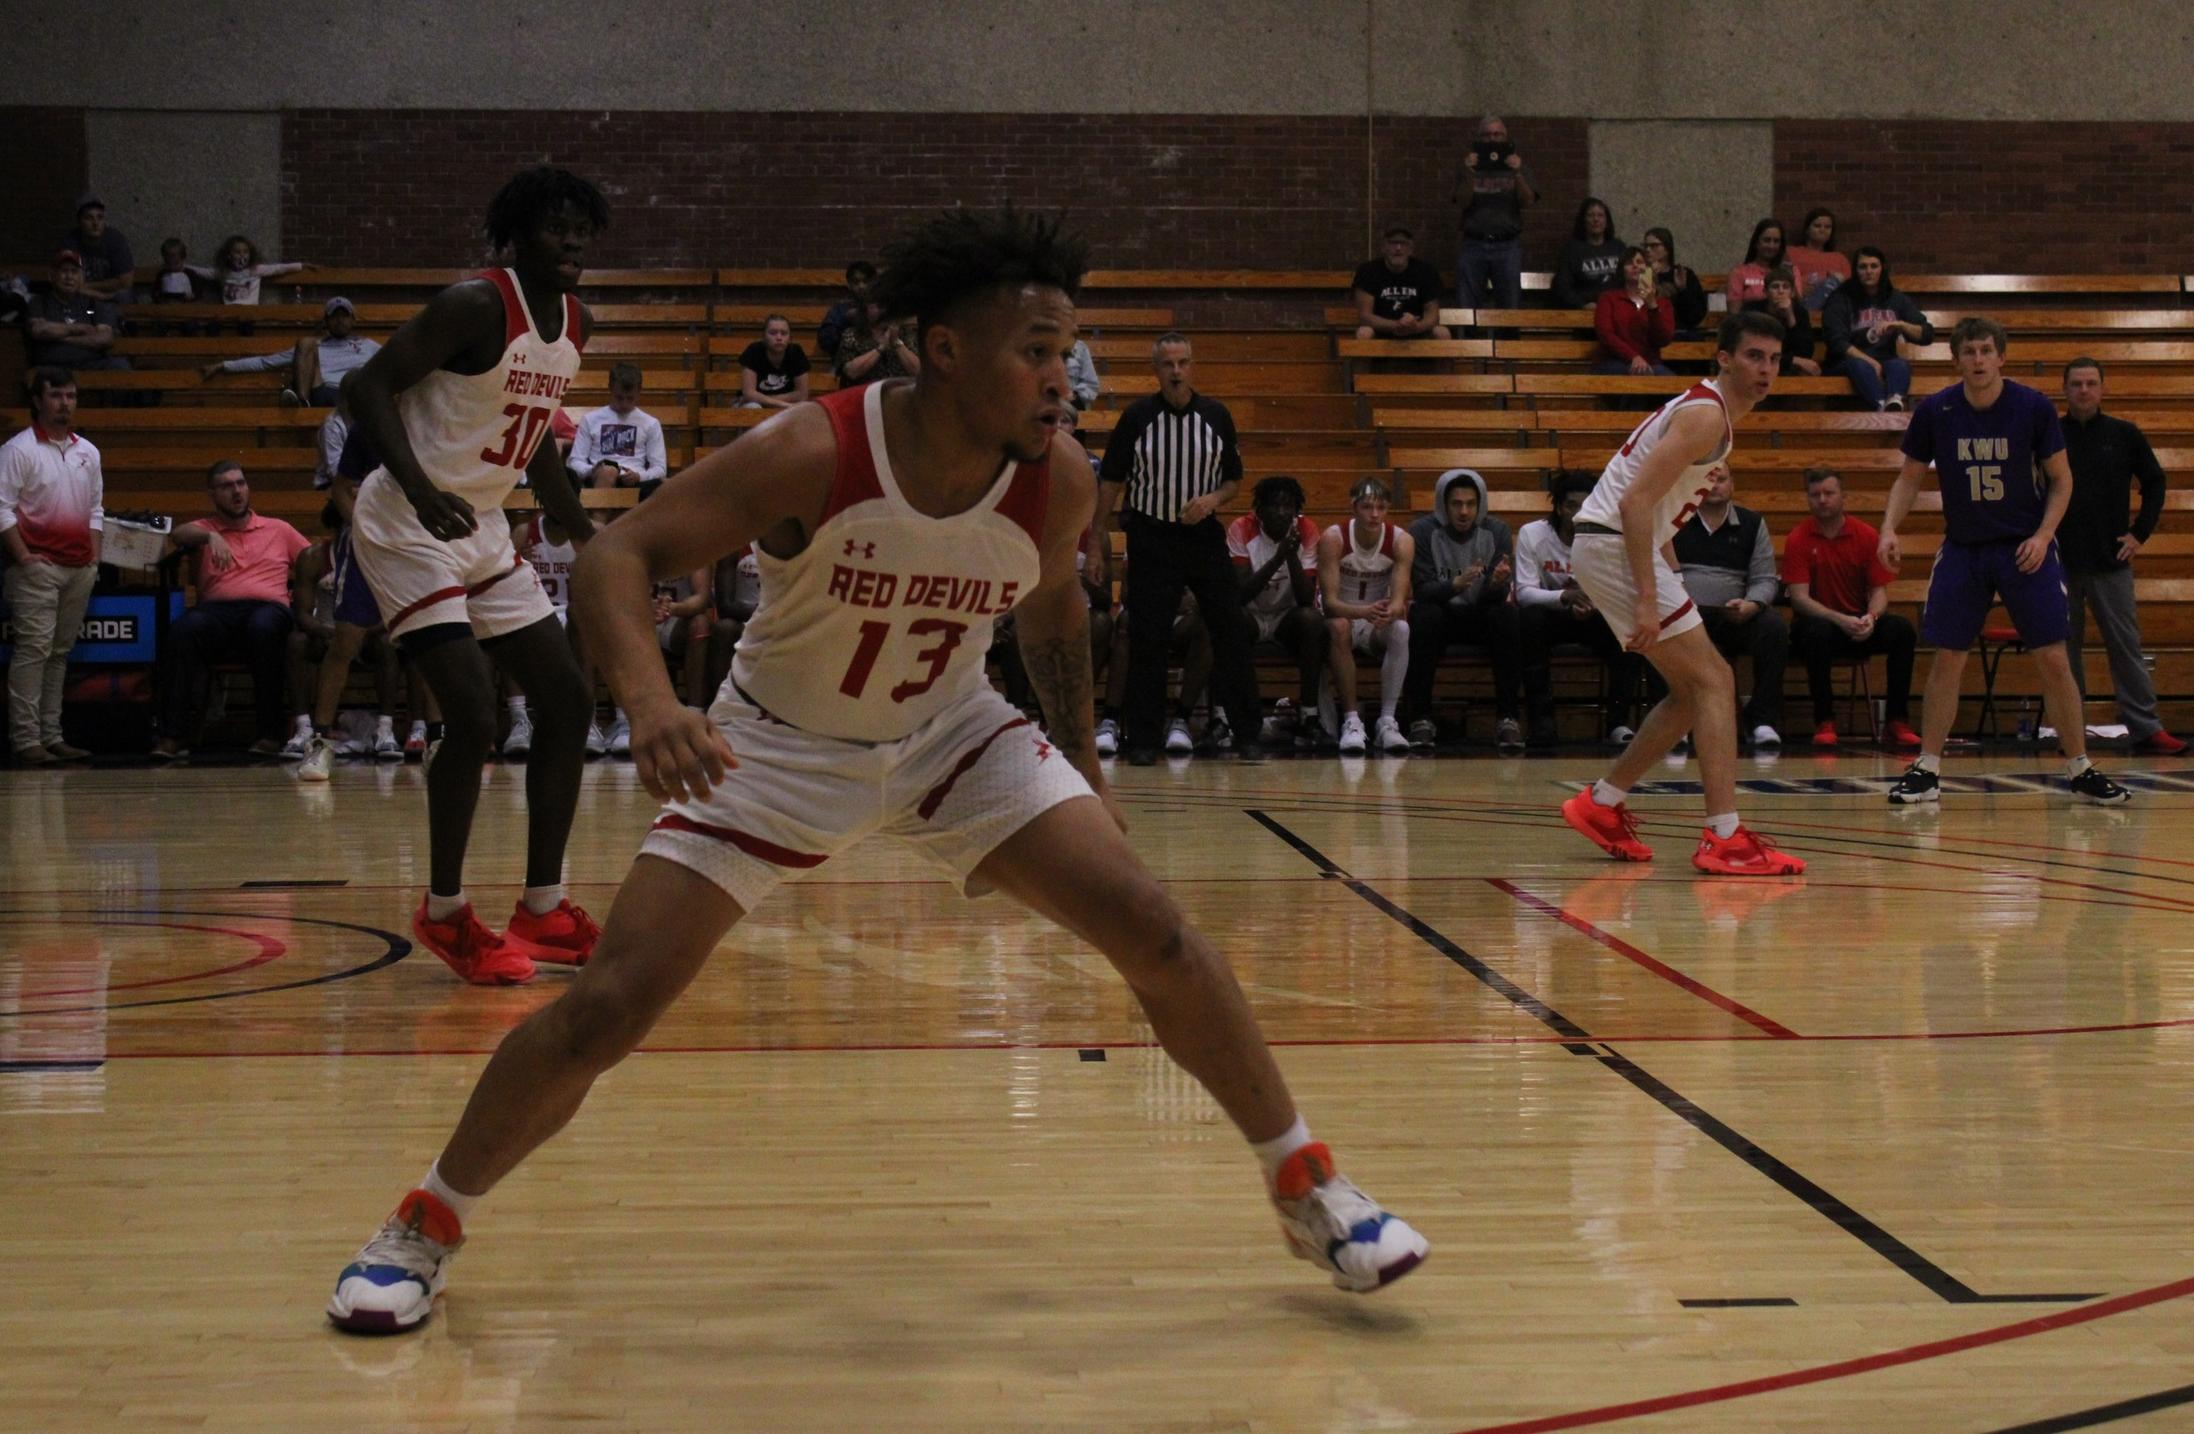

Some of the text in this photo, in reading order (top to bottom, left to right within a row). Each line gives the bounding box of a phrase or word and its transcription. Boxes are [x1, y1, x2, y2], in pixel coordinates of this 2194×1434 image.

[1581, 256, 1619, 272] ALLE
[504, 369, 532, 396] RED
[481, 403, 550, 469] 30
[1957, 438, 2008, 461] KWU
[1965, 465, 2004, 501] 15
[827, 563, 1019, 614] RED DEVILS
[839, 618, 968, 703] 13
